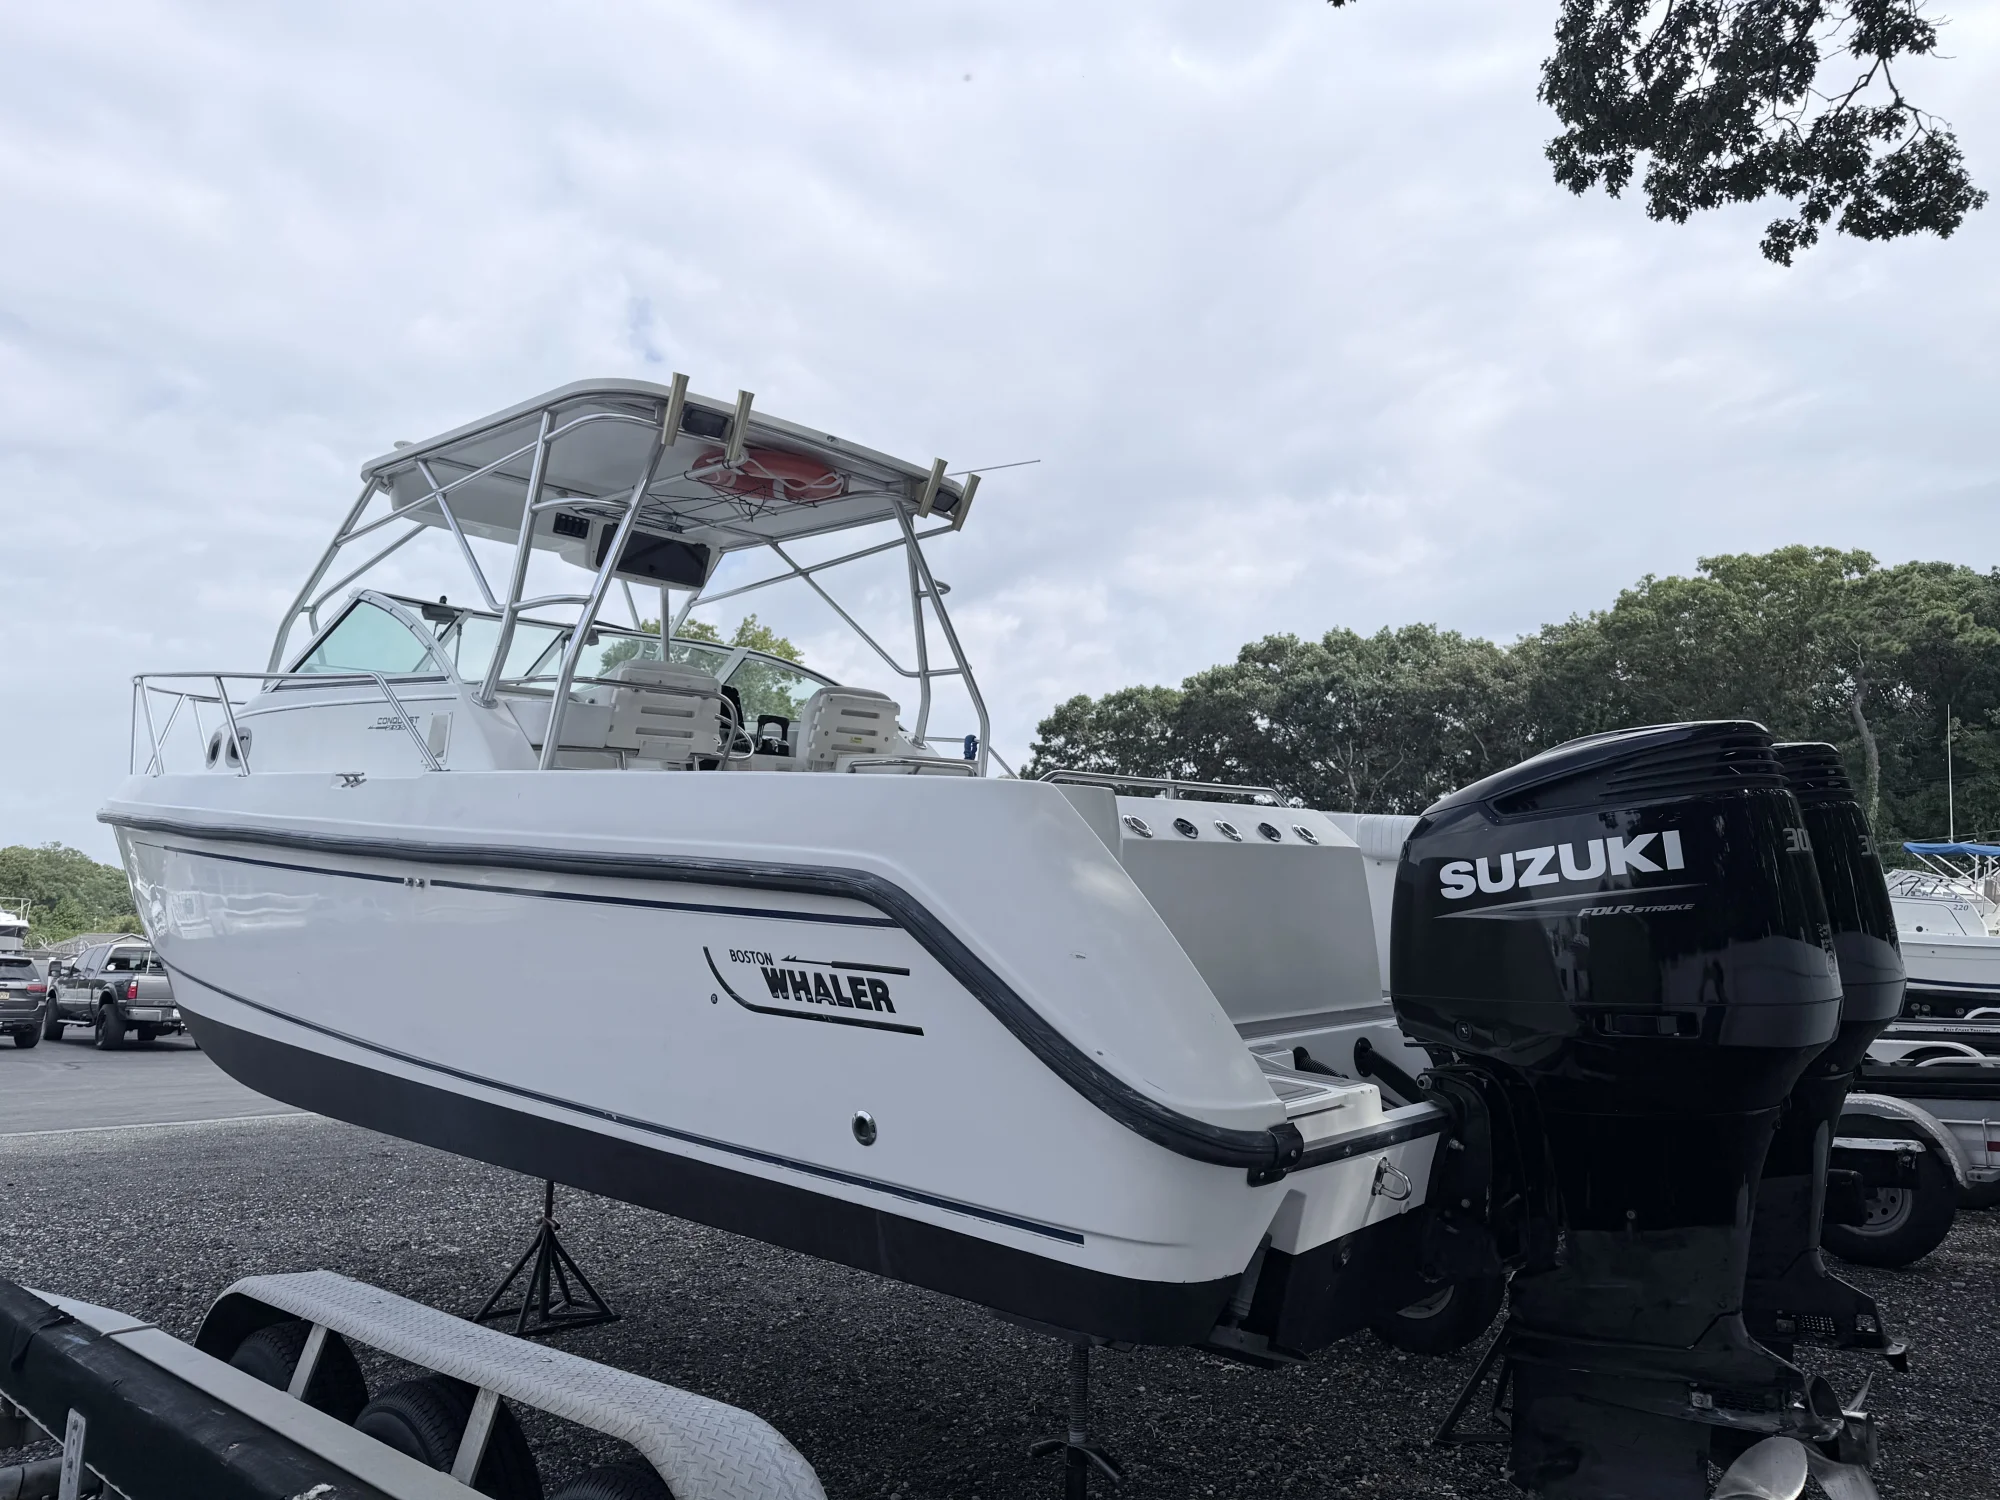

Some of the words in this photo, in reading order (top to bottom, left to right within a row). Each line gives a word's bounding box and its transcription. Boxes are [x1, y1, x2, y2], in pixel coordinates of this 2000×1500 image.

[377, 716, 420, 725] CONQUST
[1439, 830, 1685, 899] SUZUKI
[1577, 905, 1634, 917] FOUR
[1633, 904, 1696, 913] STROKE
[729, 949, 774, 966] BOSTON
[760, 967, 897, 1013] WHALER
